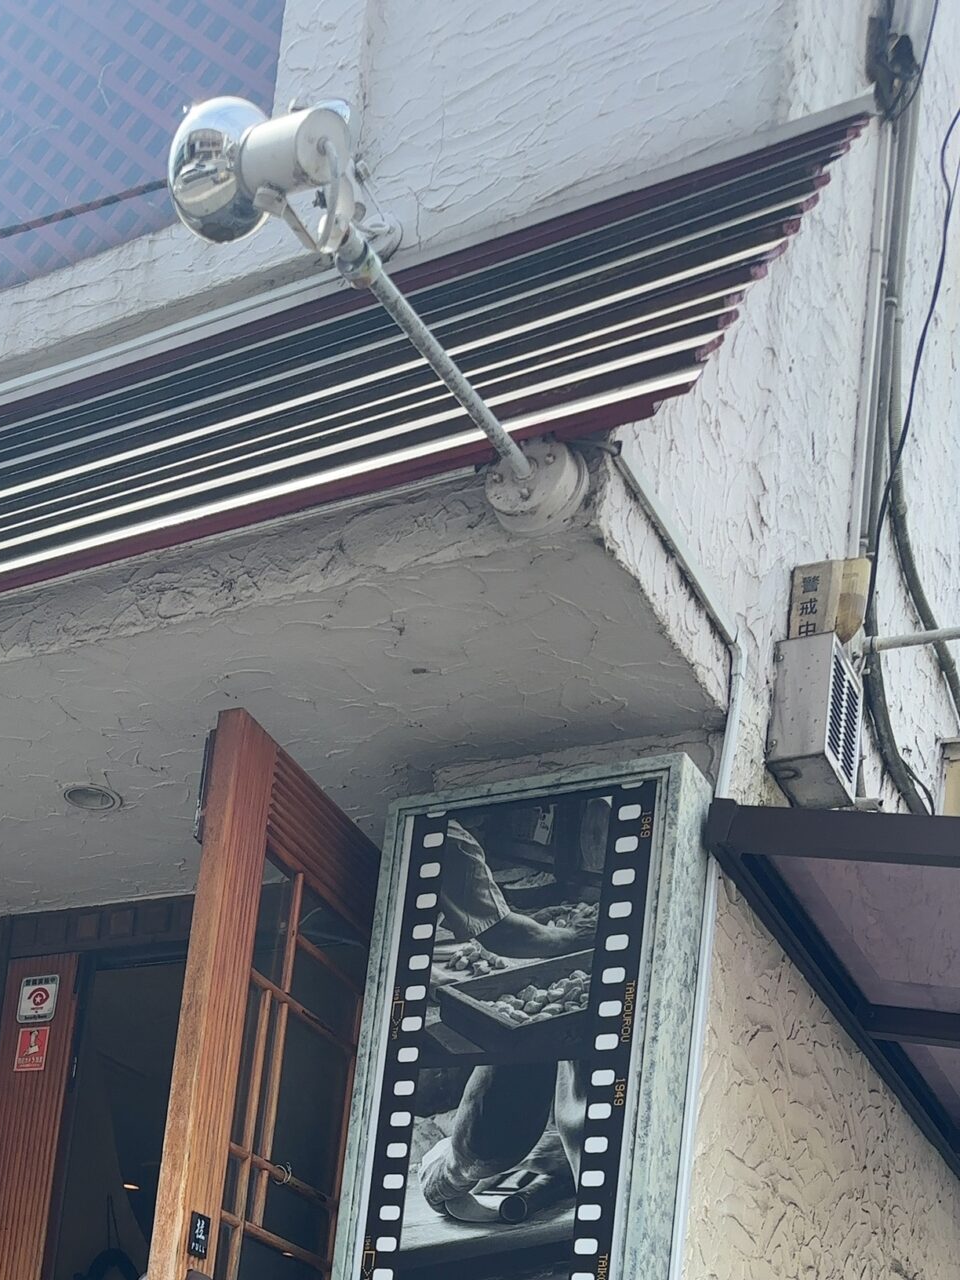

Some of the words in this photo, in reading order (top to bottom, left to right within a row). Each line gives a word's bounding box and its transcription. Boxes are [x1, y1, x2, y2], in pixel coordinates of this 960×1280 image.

[798, 575, 820, 637] 警戒中
[641, 811, 653, 838] 1949
[620, 980, 636, 1043] TAIKOUROU
[613, 1077, 626, 1107] 1949
